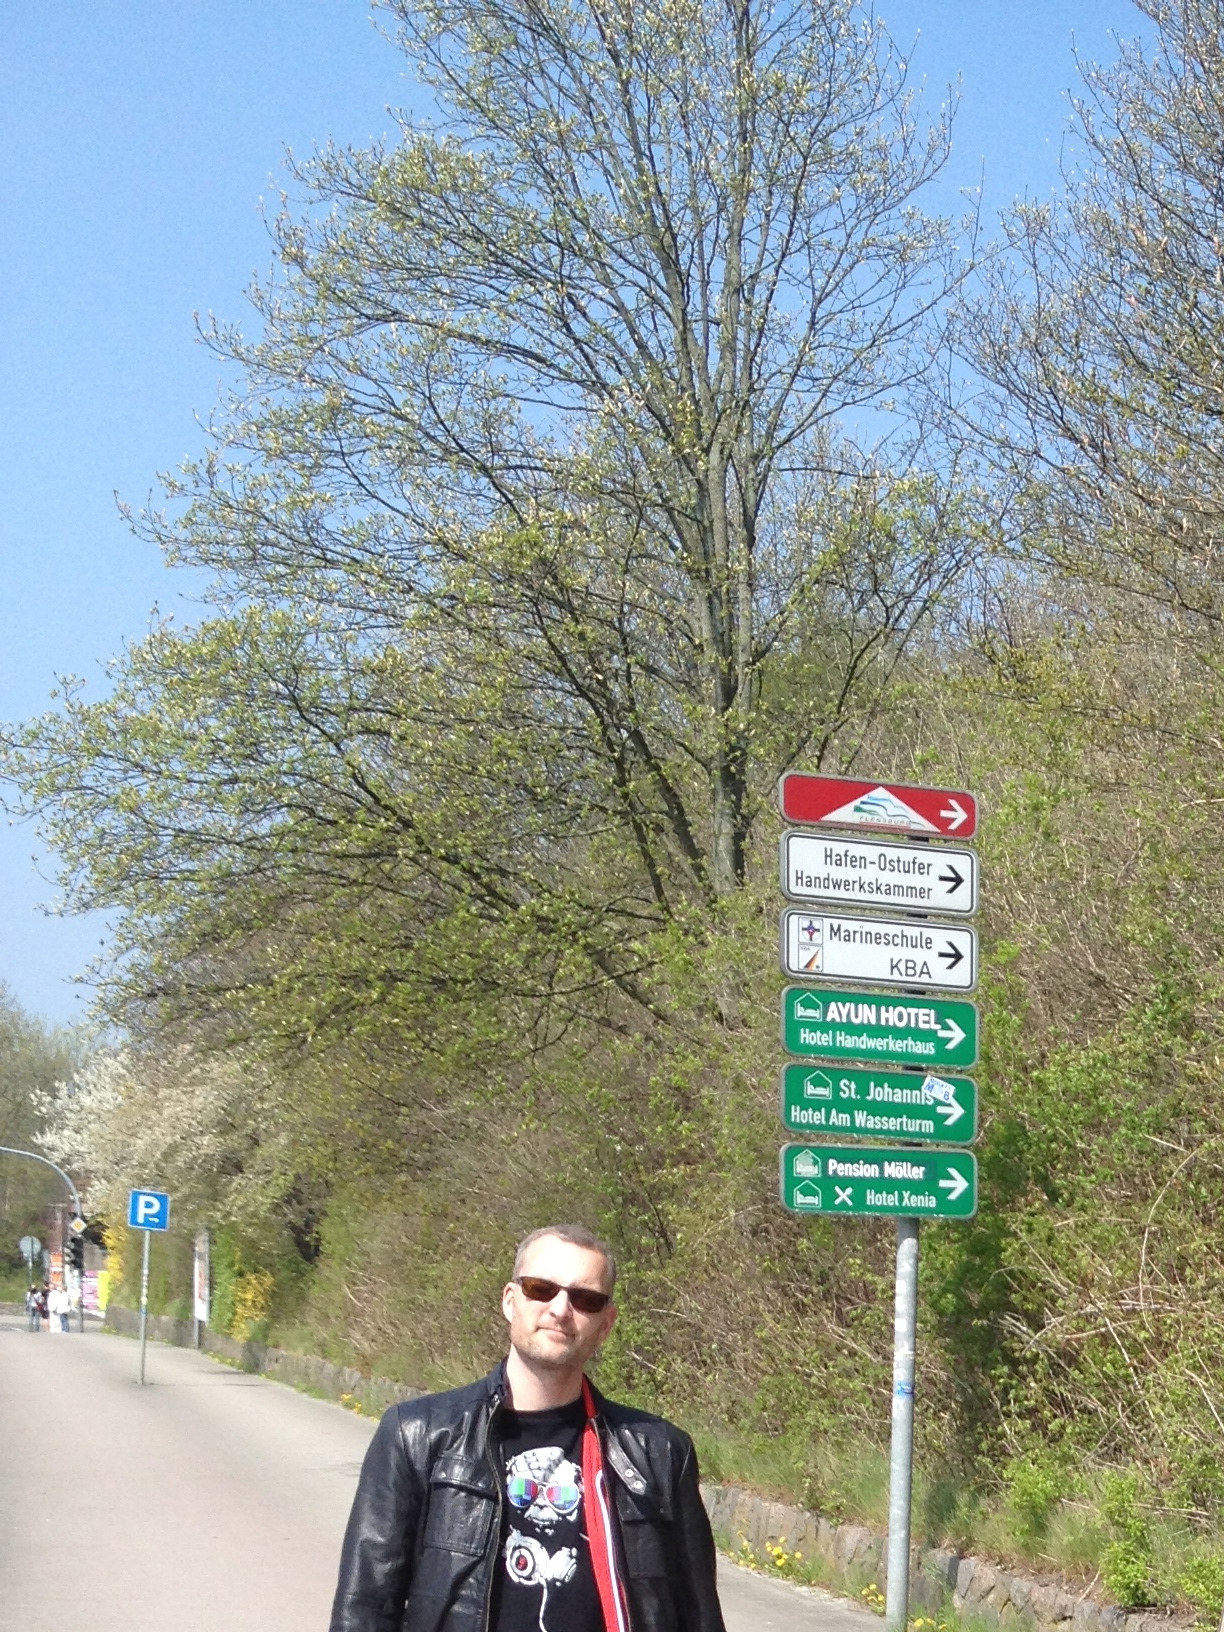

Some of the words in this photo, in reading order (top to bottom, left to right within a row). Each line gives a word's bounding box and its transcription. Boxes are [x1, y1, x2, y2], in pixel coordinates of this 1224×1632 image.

[823, 847, 933, 876] Hafen-Ostufer
[795, 870, 933, 900] Handwerkskammer
[829, 922, 933, 950] Marineschule
[889, 957, 932, 979] KBA
[826, 1001, 876, 1026] AYUN
[880, 1005, 942, 1030] HOTEL
[800, 1028, 833, 1047] Hotel
[836, 1032, 936, 1056] Handwerkerhaus
[839, 1078, 861, 1100] St.
[790, 1105, 826, 1125] Hotel
[829, 1109, 851, 1127] Am
[854, 1110, 934, 1133] Wasserturm
[828, 1158, 879, 1177] Pension
[884, 1161, 925, 1179] Möller
[136, 1194, 161, 1224] P
[866, 1188, 899, 1207] Hotel
[902, 1190, 937, 1208] Xenia
